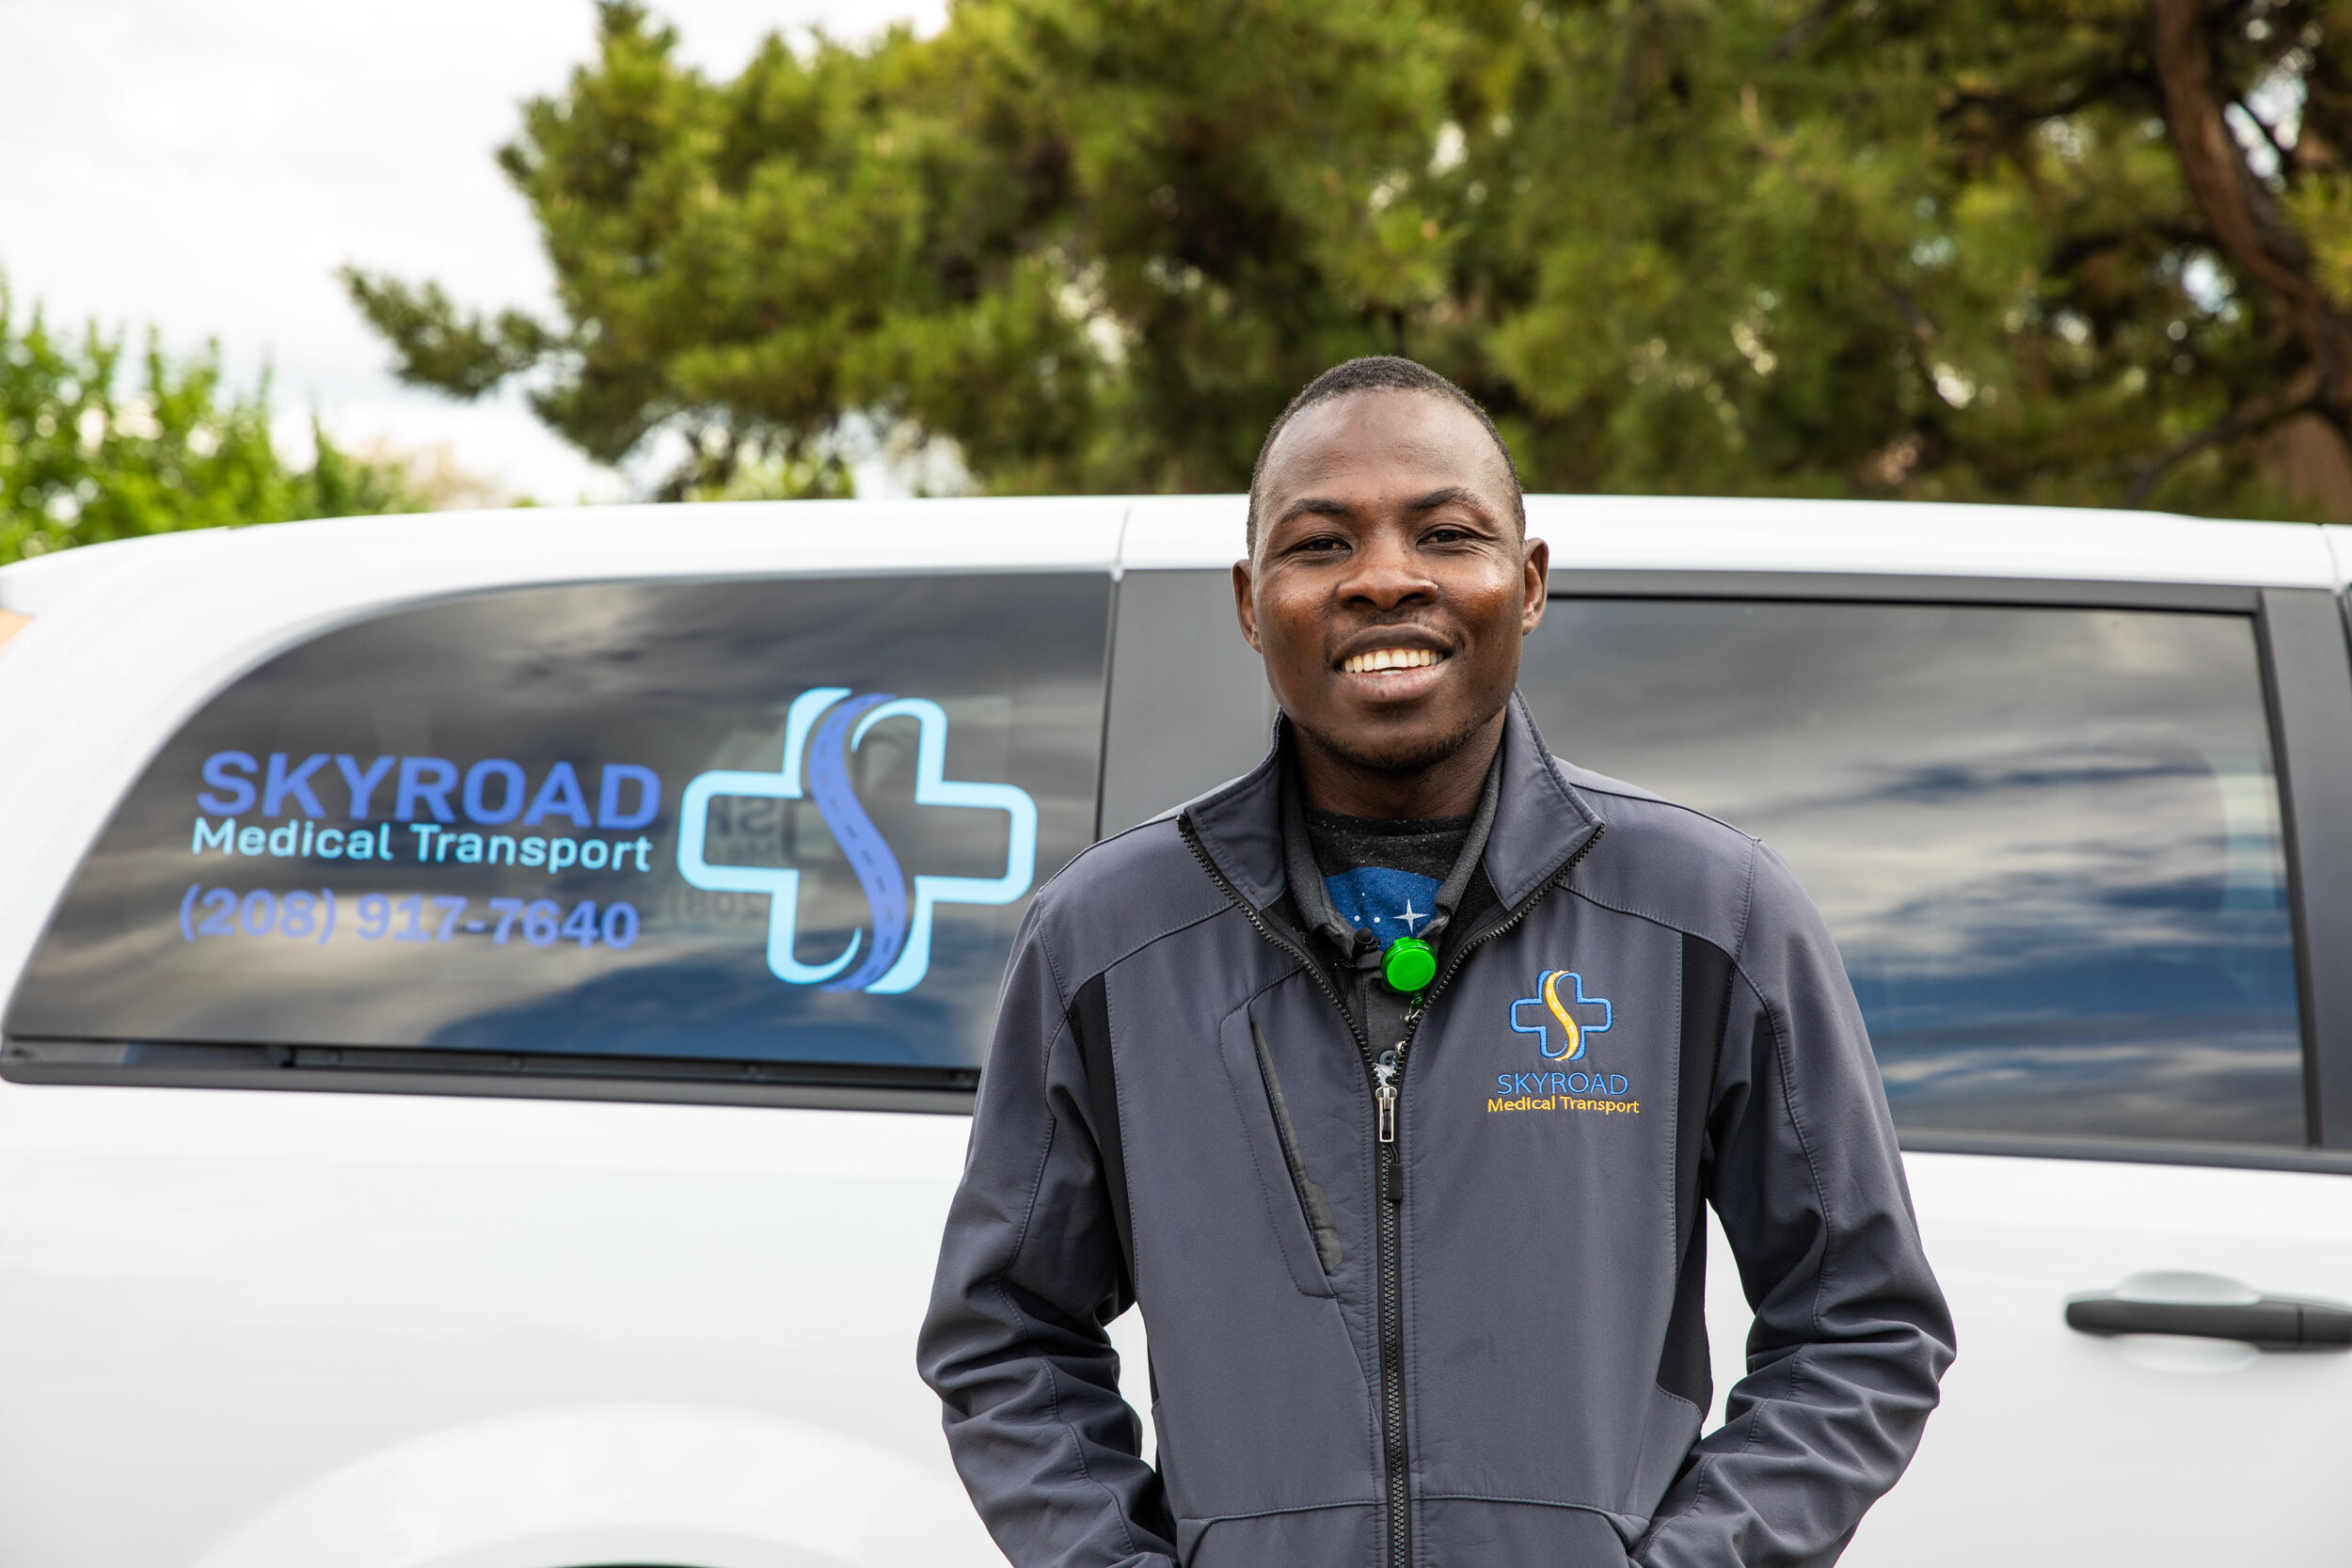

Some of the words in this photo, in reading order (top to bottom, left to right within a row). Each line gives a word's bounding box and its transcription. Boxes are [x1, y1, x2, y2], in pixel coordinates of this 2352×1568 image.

[198, 750, 662, 832] SKYROAD
[191, 816, 395, 863] Medical
[409, 822, 656, 875] Transport
[179, 882, 337, 945] (208)
[357, 892, 644, 951] 917-7640
[1487, 1095, 1557, 1114] Medical
[1559, 1095, 1640, 1116] Transport
[1497, 1072, 1630, 1096] SKYROAD
